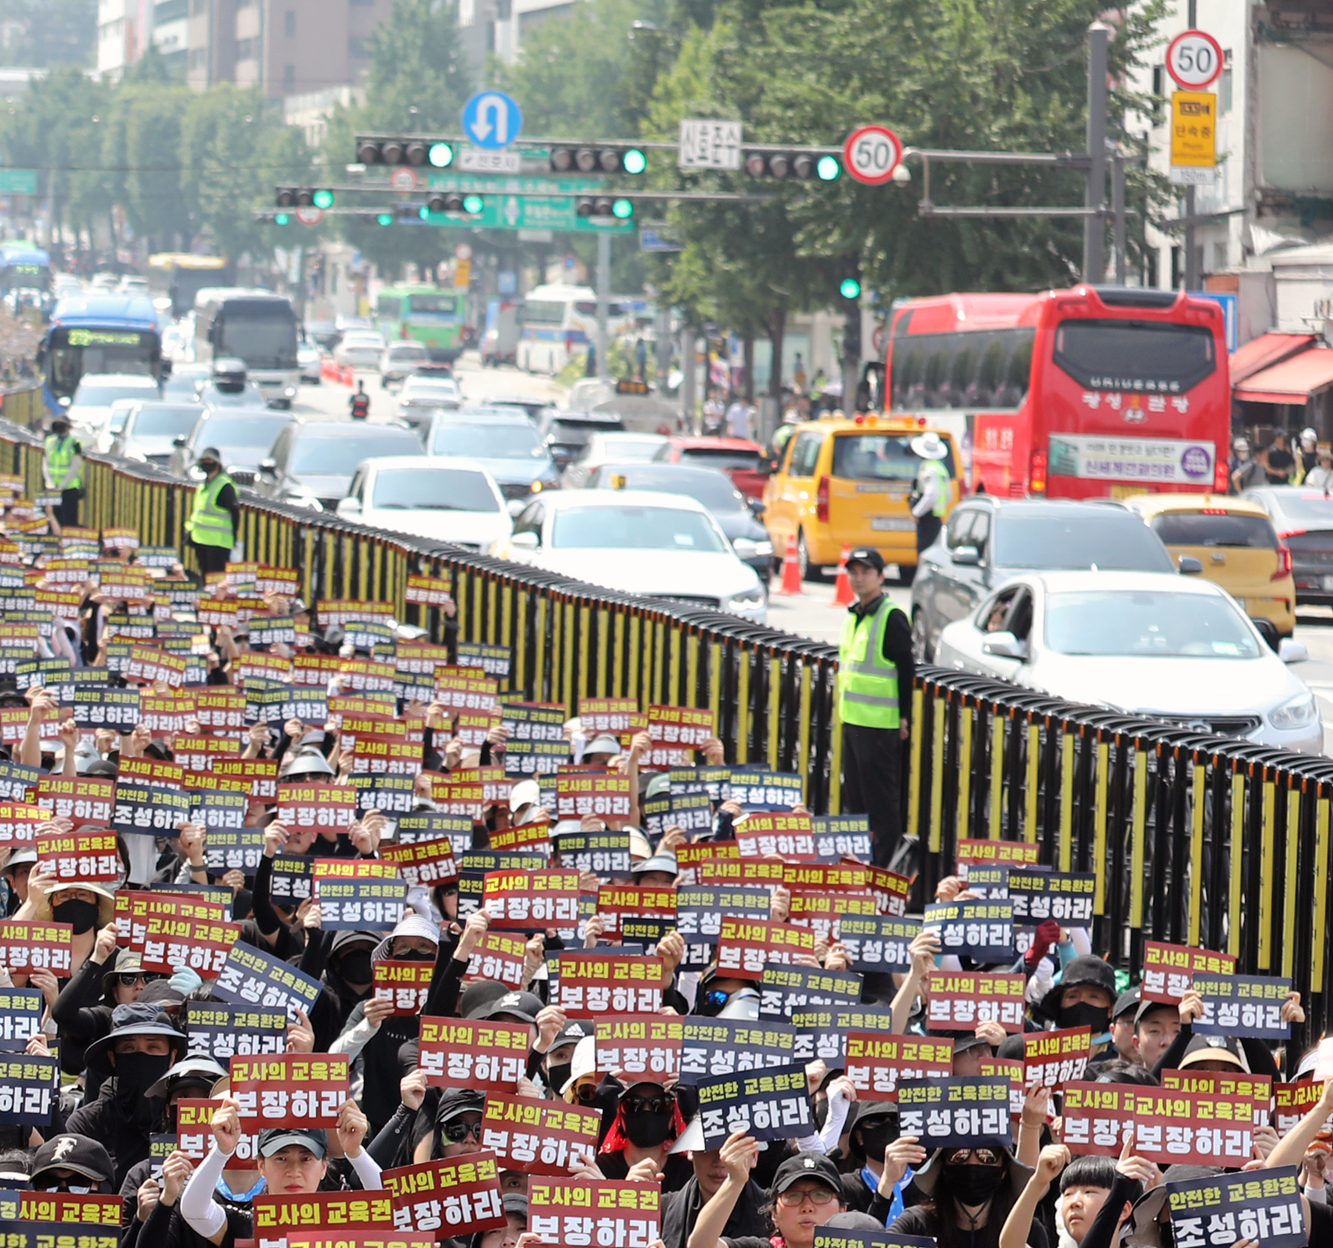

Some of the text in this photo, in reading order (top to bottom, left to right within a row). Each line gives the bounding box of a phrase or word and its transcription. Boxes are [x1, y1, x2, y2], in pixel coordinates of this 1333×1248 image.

[1178, 47, 1211, 73] 50
[682, 122, 740, 167] 신호준수
[1176, 127, 1211, 138] 단속중
[858, 142, 888, 170] 50
[279, 789, 355, 803] 교사의 교육권
[422, 1024, 527, 1049] 교사의 교육권
[418, 1051, 526, 1083] 보장하라
[898, 1085, 1007, 1103] 안전한 교육환경
[1137, 1097, 1252, 1121] 교사의 교육권
[898, 1108, 1009, 1137] 조성하라
[1136, 1125, 1253, 1157] 보장하라
